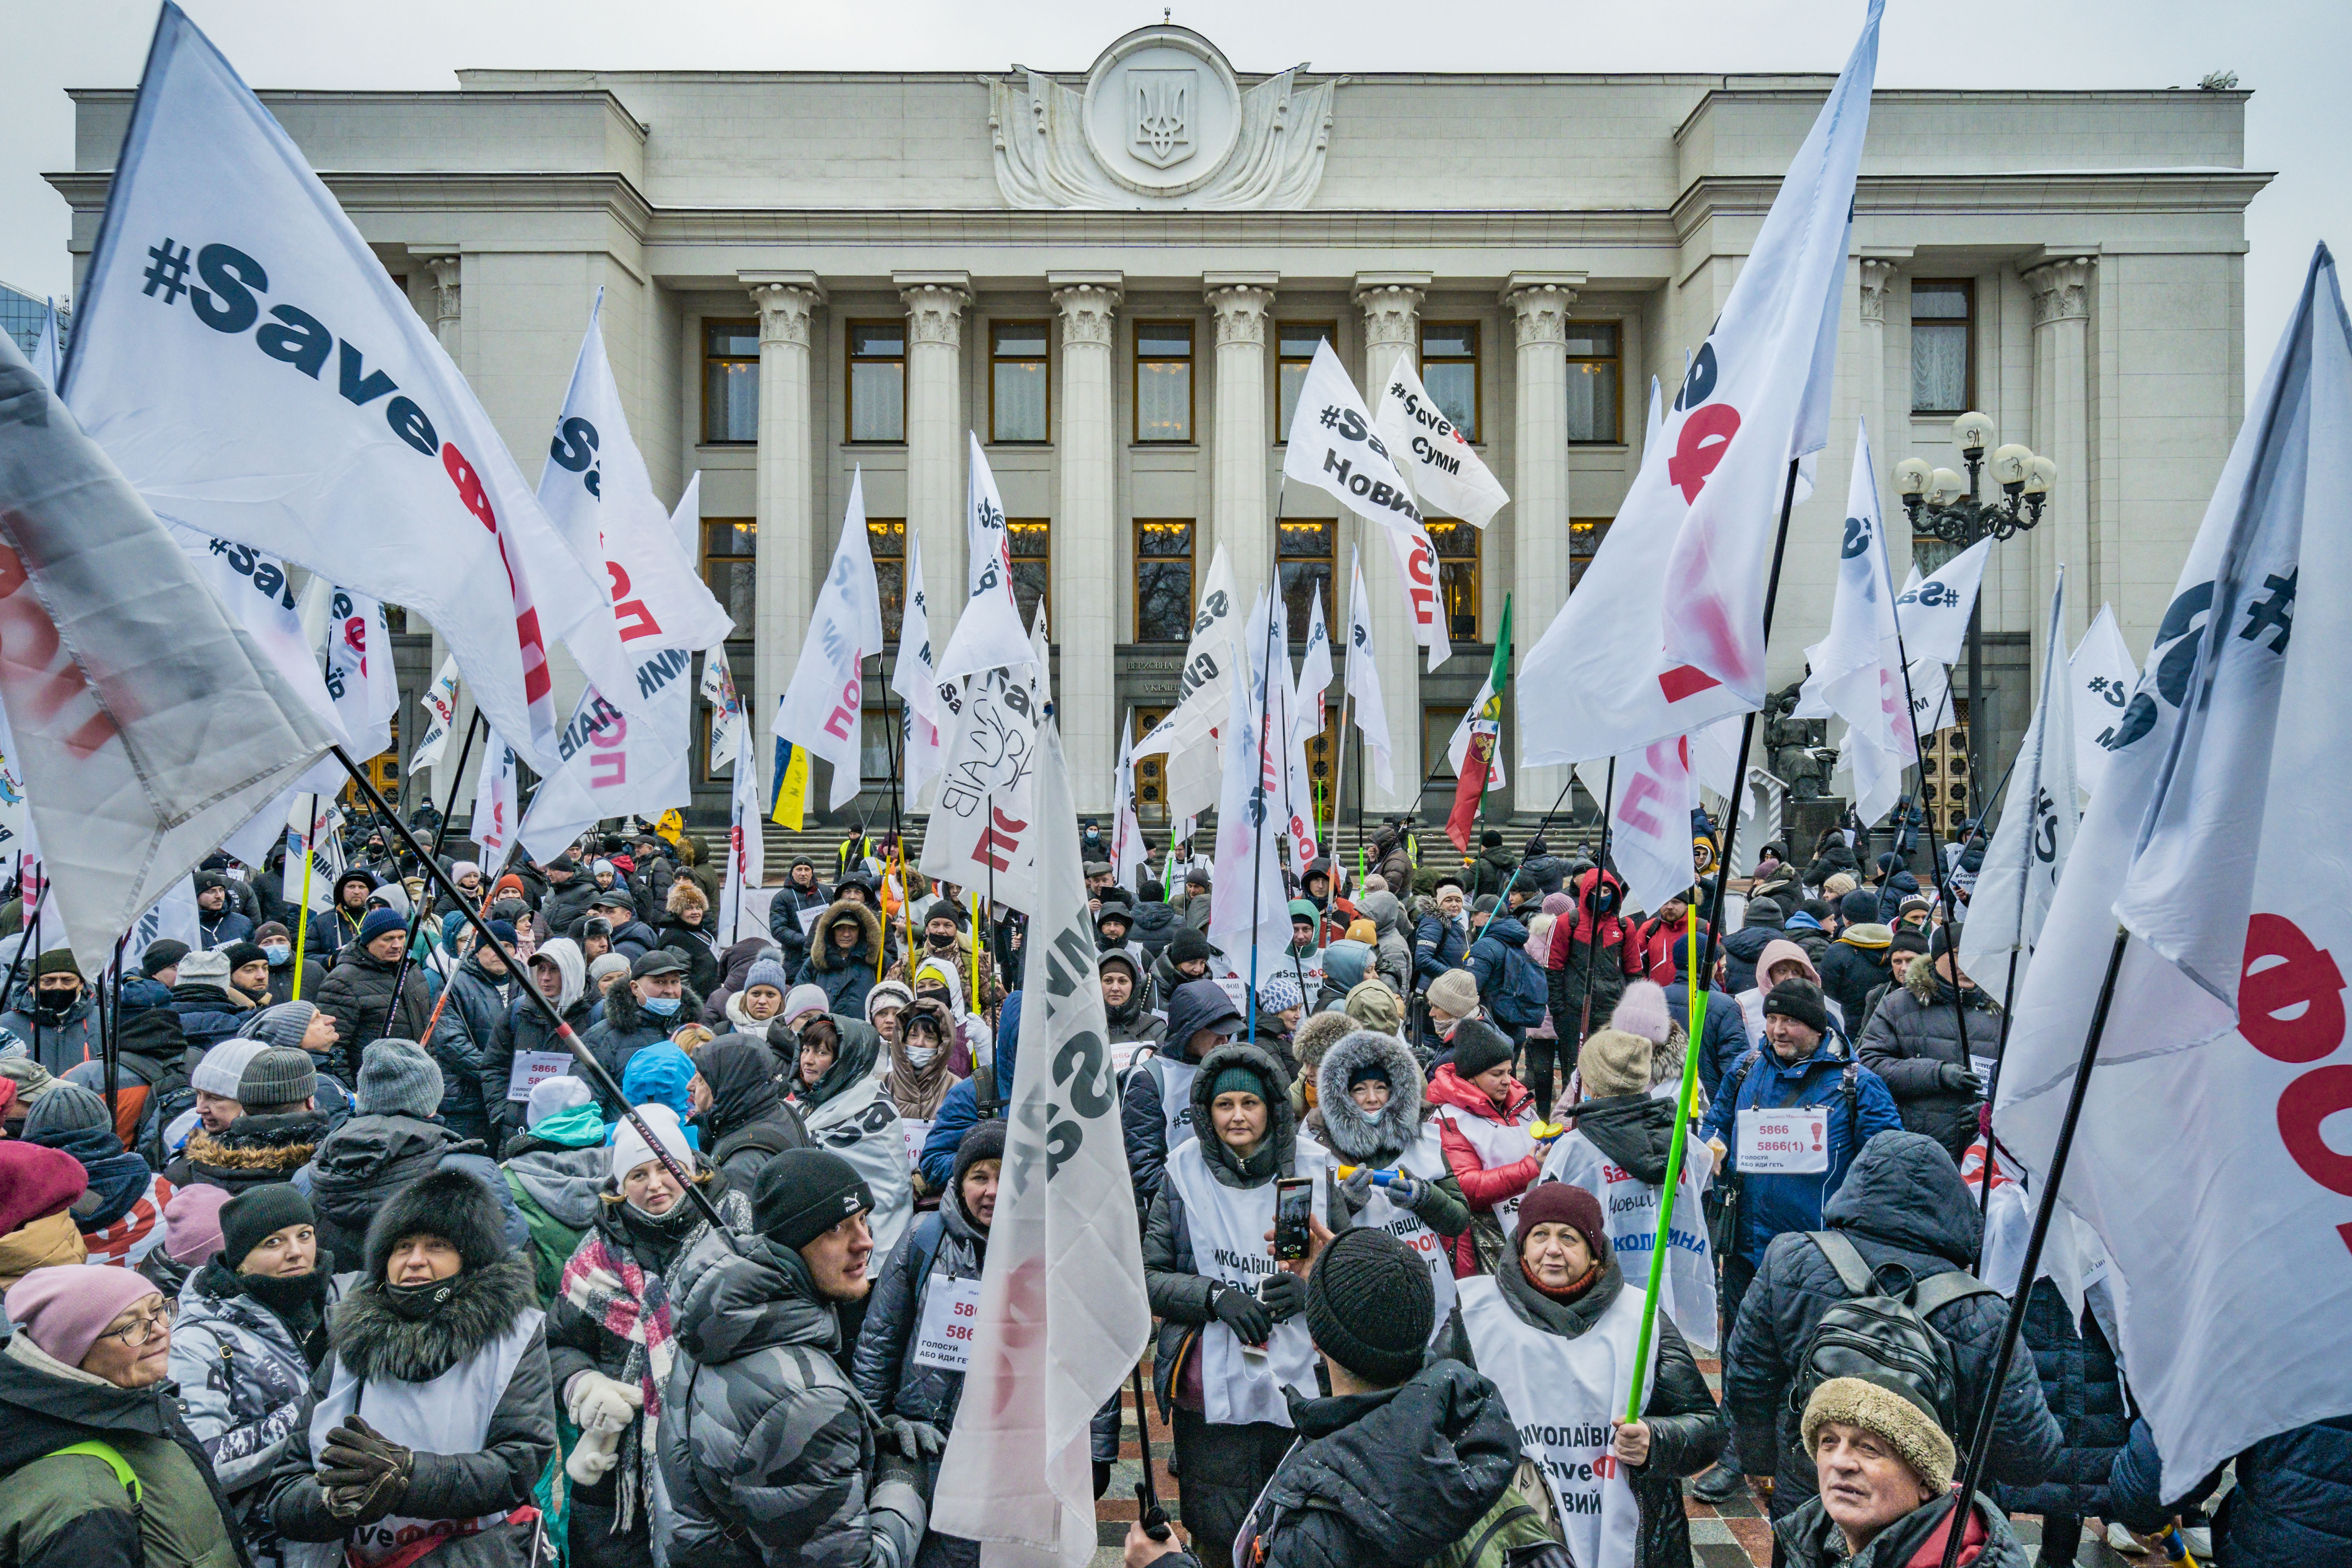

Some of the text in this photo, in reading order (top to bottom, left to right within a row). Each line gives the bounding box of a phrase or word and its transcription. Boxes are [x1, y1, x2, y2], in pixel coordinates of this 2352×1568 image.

[532, 1065, 557, 1073] 5866
[1760, 1125, 1789, 1134] 5866
[1757, 1142, 1804, 1153] 5866(1)
[845, 1203, 858, 1213] PUMA
[922, 1340, 959, 1352] ГОЛОСУЙ
[938, 1352, 955, 1362] ЙДИ
[1560, 1488, 1602, 1515] ВИЙ
